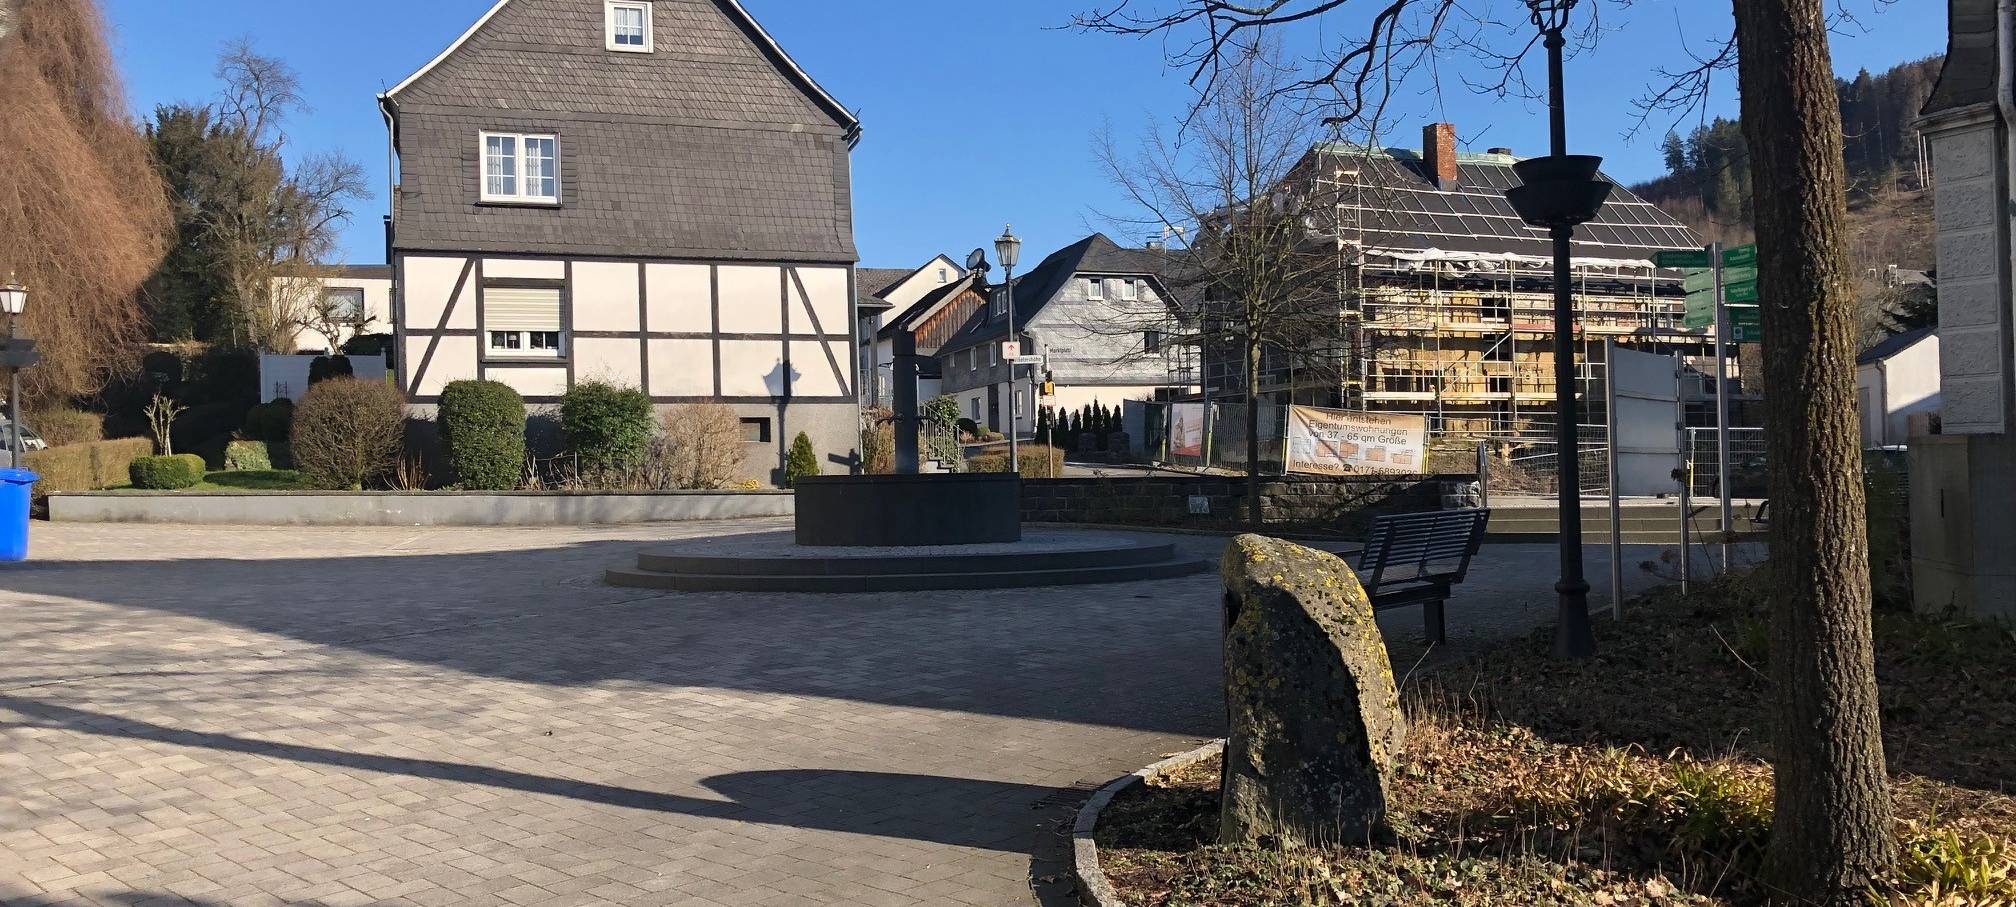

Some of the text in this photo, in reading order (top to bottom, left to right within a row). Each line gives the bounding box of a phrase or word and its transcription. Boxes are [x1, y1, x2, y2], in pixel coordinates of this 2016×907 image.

[1326, 413, 1344, 422] Hier
[1308, 420, 1408, 436] Eigentumswohnungen
[1308, 430, 1325, 438] von
[1327, 431, 1338, 439] 37
[1347, 432, 1359, 440] 65
[1361, 435, 1375, 443] qm
[1378, 435, 1407, 445] Größe
[1293, 459, 1339, 471] Interesse?
